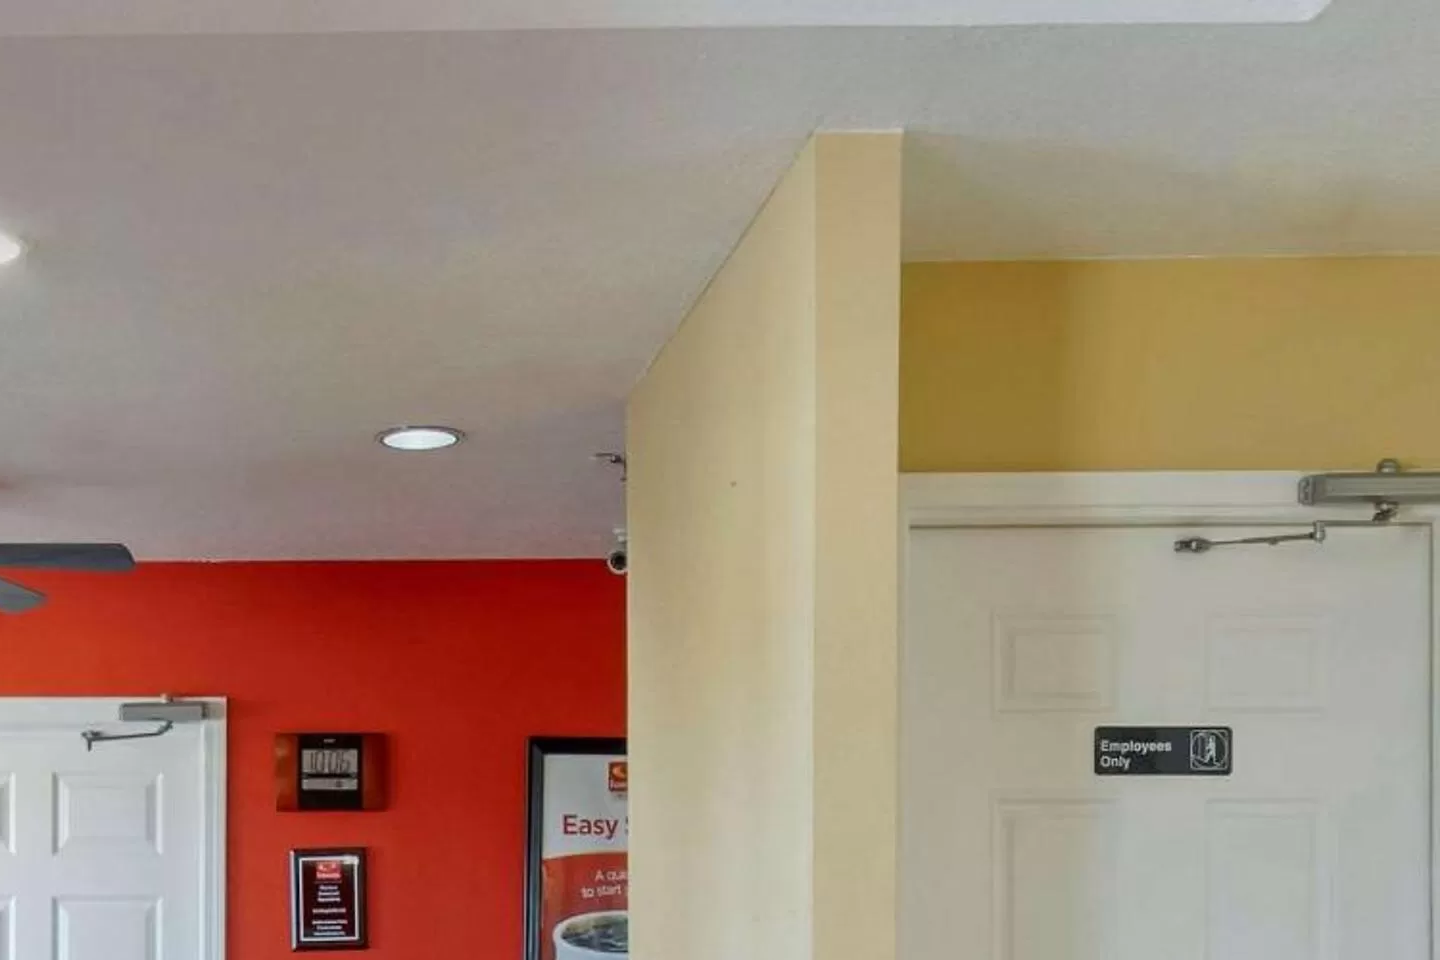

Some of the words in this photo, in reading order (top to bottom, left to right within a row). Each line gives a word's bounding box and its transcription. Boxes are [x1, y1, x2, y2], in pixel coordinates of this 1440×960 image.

[1100, 739, 1172, 755] Employees
[1100, 755, 1131, 770] Only
[563, 814, 618, 840] Easy
[580, 886, 594, 898] to
